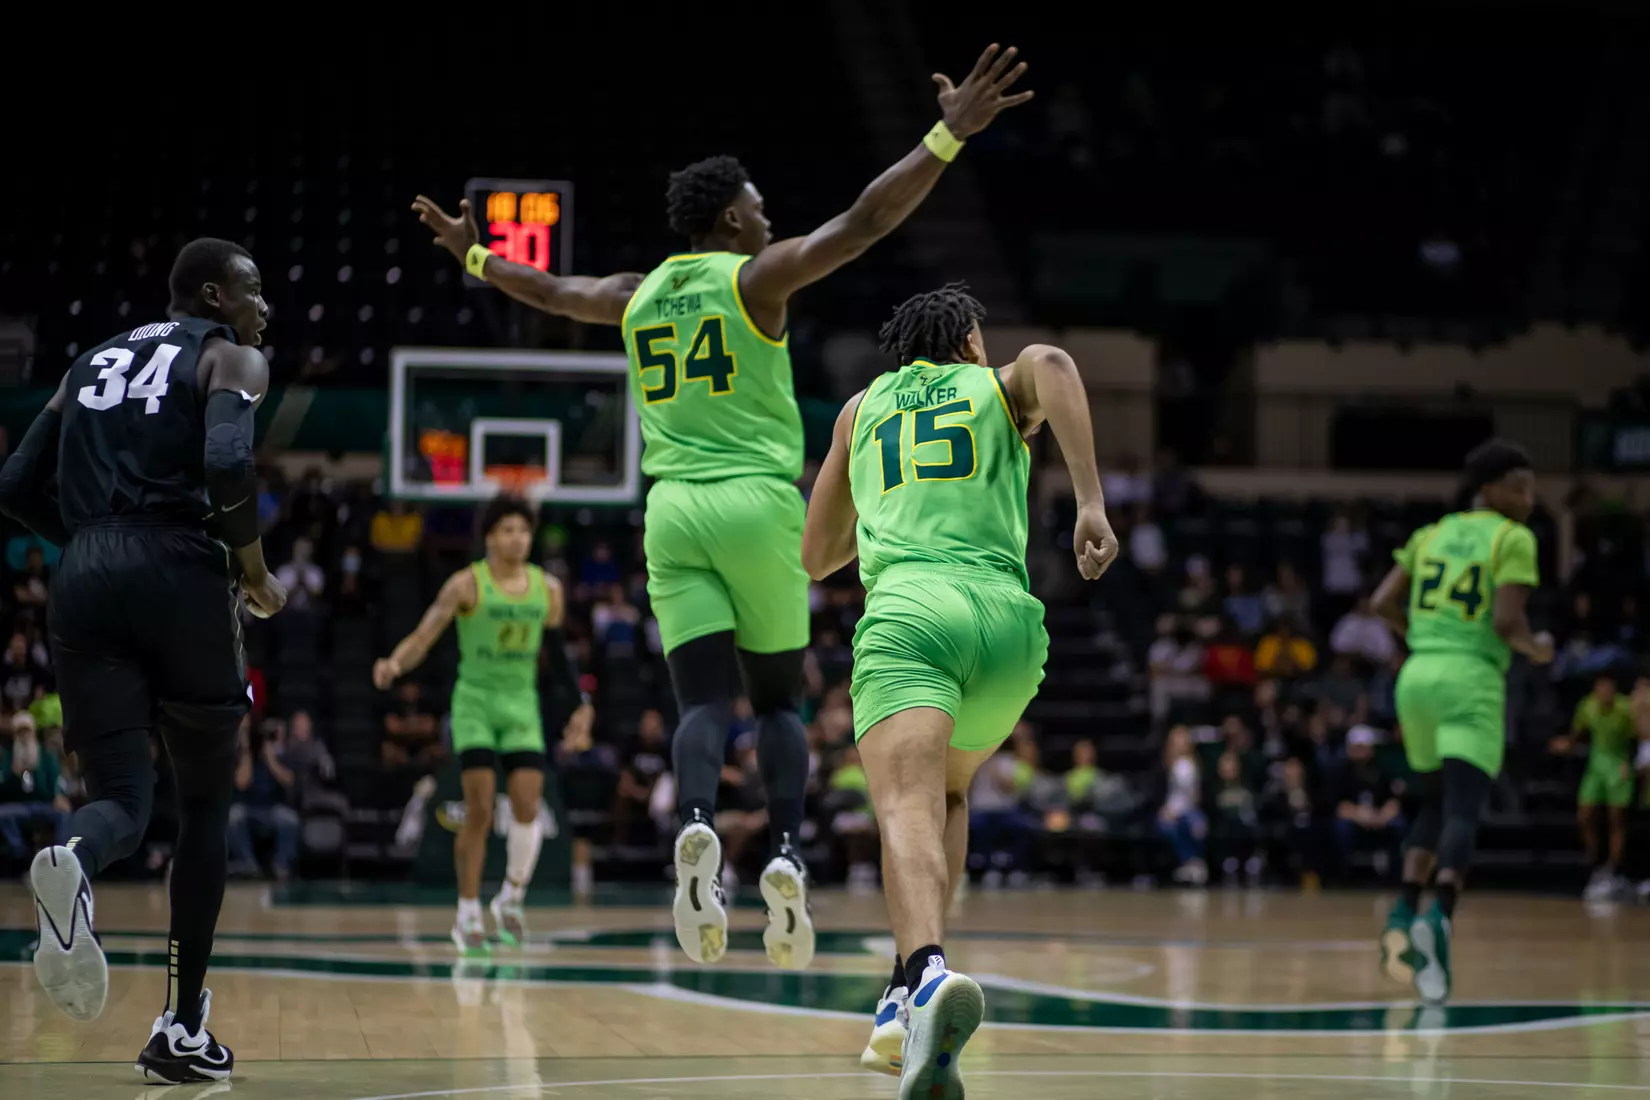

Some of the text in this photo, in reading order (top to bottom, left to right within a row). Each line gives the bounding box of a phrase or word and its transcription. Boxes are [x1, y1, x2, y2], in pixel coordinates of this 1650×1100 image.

[77, 343, 182, 415] 34
[632, 315, 738, 405] 54
[894, 384, 958, 410] WALKER
[872, 397, 976, 495] 15
[1417, 559, 1485, 619] 24
